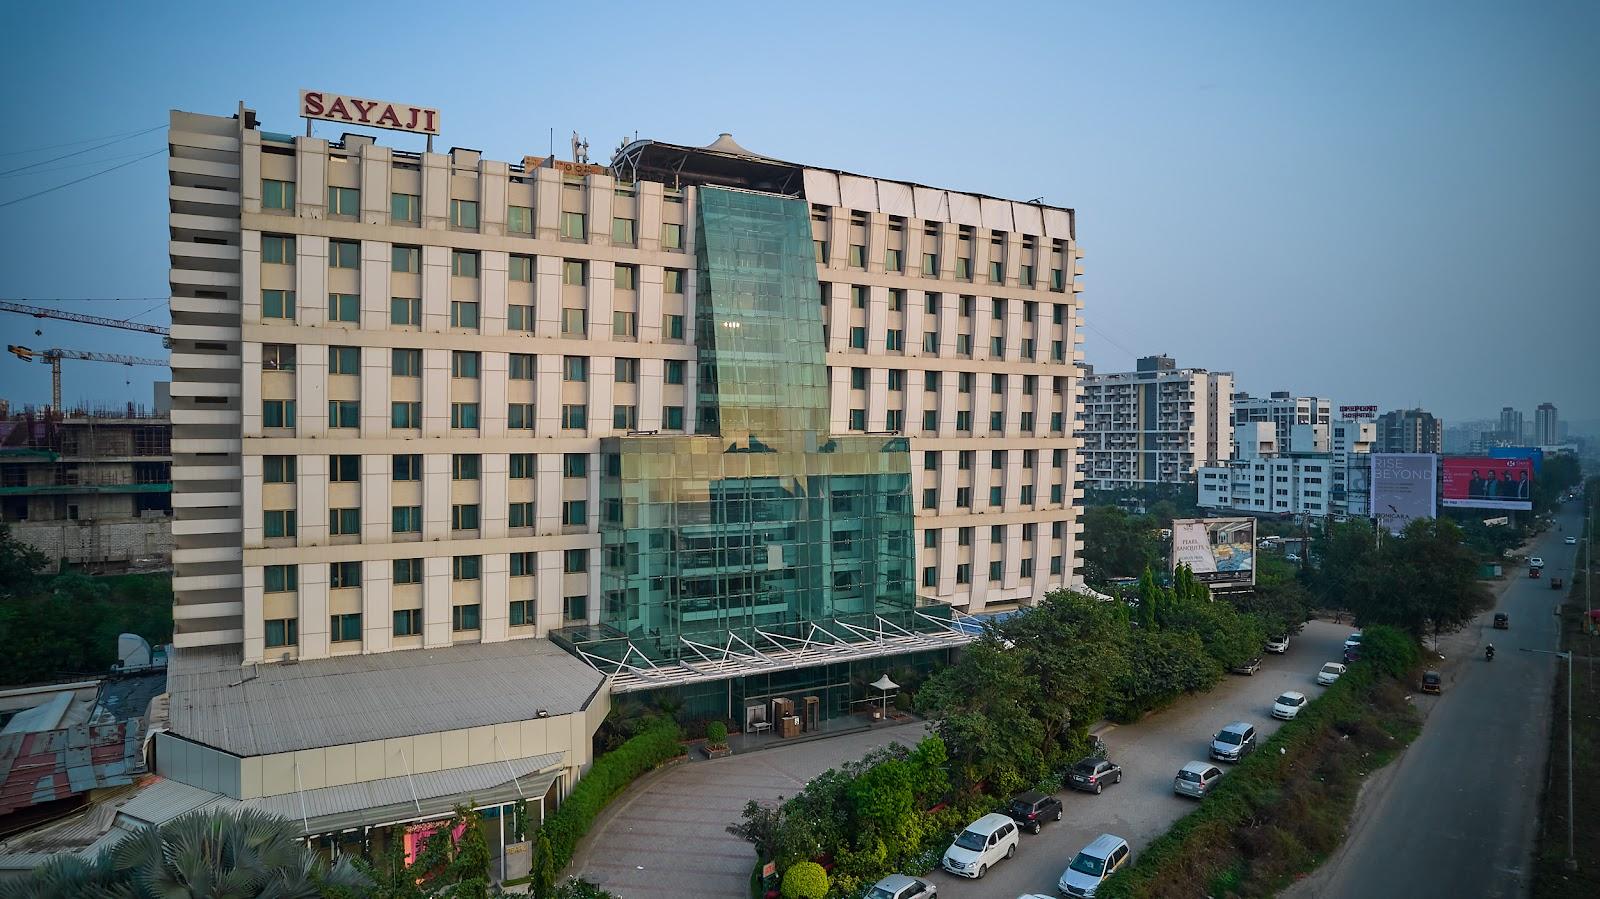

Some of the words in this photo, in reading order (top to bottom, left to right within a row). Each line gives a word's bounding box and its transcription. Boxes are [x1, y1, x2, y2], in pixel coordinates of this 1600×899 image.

[305, 92, 436, 131] SAYAJI
[1375, 458, 1404, 469] RISE
[1375, 469, 1433, 480] BEYOND
